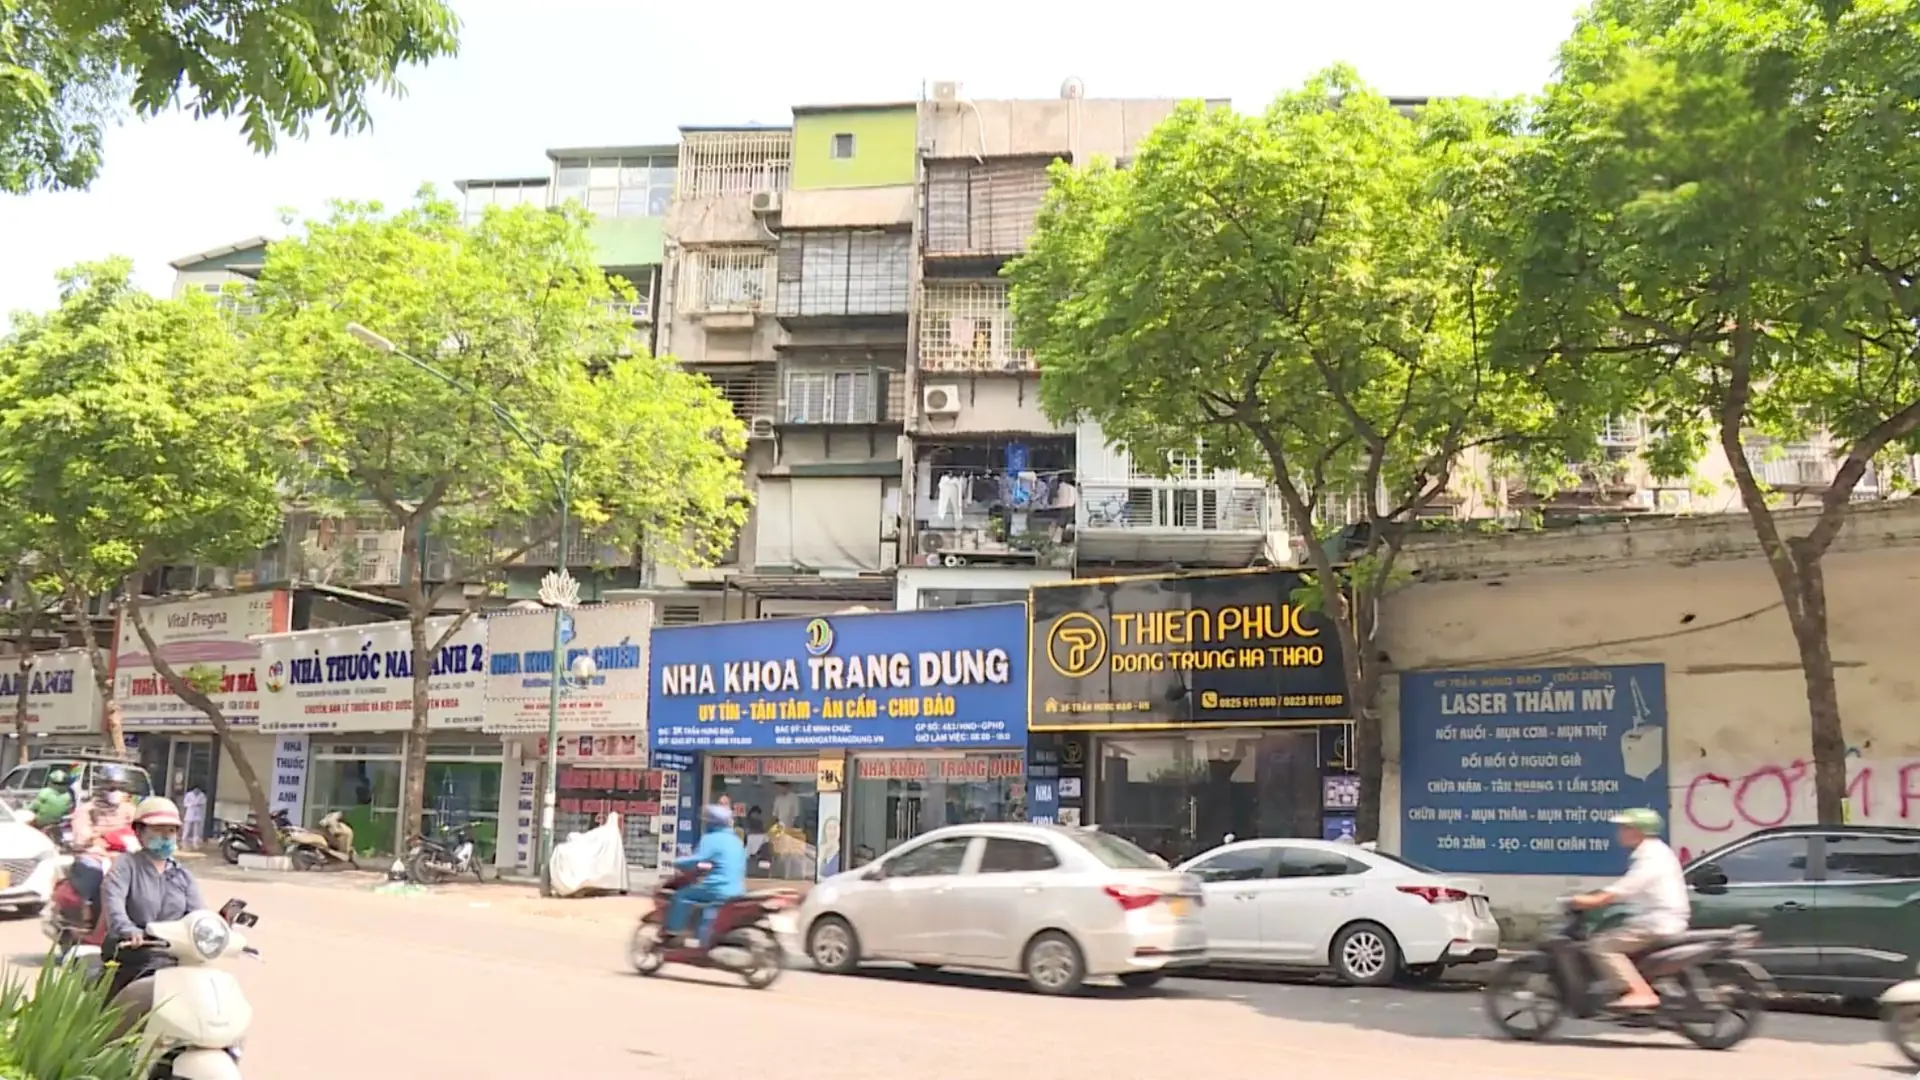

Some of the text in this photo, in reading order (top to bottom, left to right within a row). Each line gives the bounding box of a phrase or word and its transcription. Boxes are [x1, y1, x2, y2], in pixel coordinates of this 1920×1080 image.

[167, 612, 227, 628] Vital Pregna
[1112, 604, 1319, 646] THIEN PHUC
[290, 649, 323, 684] NHÀ
[326, 640, 380, 682] THUỐC
[385, 650, 414, 678] NA
[472, 644, 483, 672] 2
[1112, 646, 1323, 672] DONG TRUNG HA THAO
[31, 671, 74, 694] ANH
[662, 648, 1009, 696] NHA KHOA TRANG DUNG
[698, 704, 716, 722] UY
[779, 698, 811, 720] TÂM
[888, 697, 920, 718] CHU
[1441, 682, 1616, 714] LASER THẨM MỸ
[860, 760, 886, 777] NHA
[990, 760, 1024, 776] DUN
[1035, 784, 1052, 801] NHA
